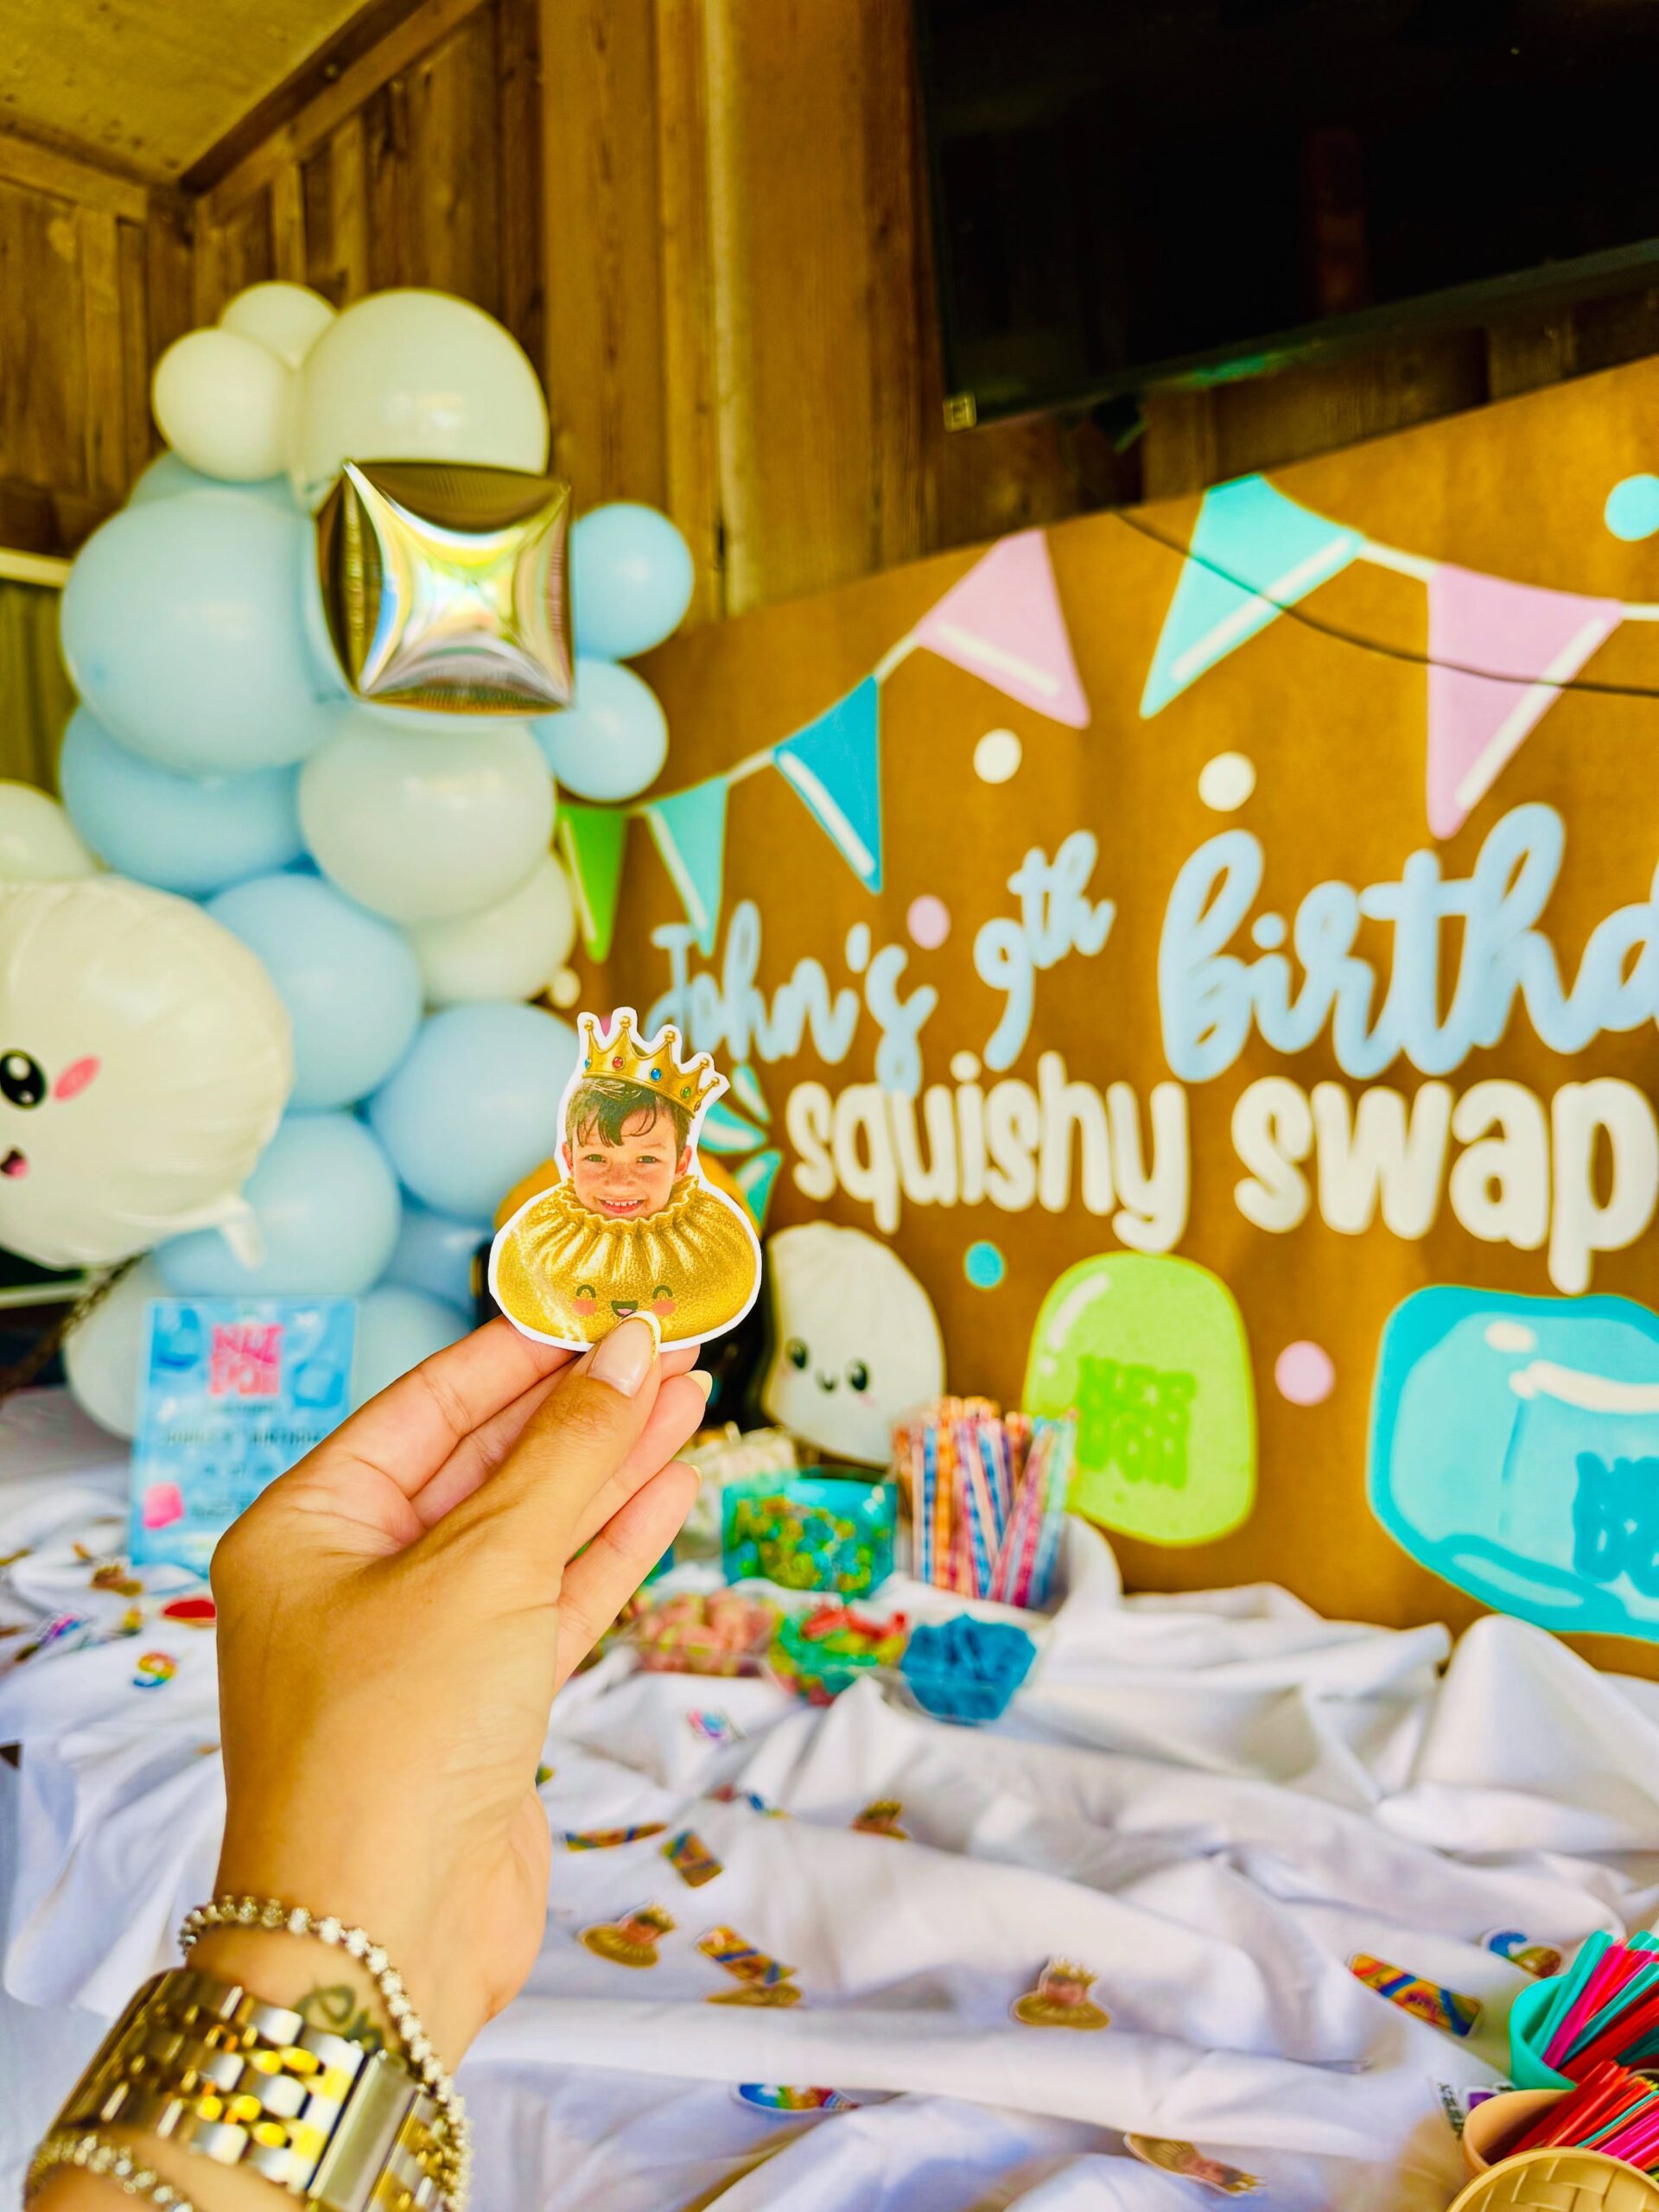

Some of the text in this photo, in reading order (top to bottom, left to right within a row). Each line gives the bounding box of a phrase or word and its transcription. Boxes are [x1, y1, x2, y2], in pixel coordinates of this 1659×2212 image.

[644, 900, 938, 1099] John's
[974, 830, 1116, 1071] 9th
[786, 1051, 1659, 1296] squishy swap
[133, 1651, 178, 1688] 9
